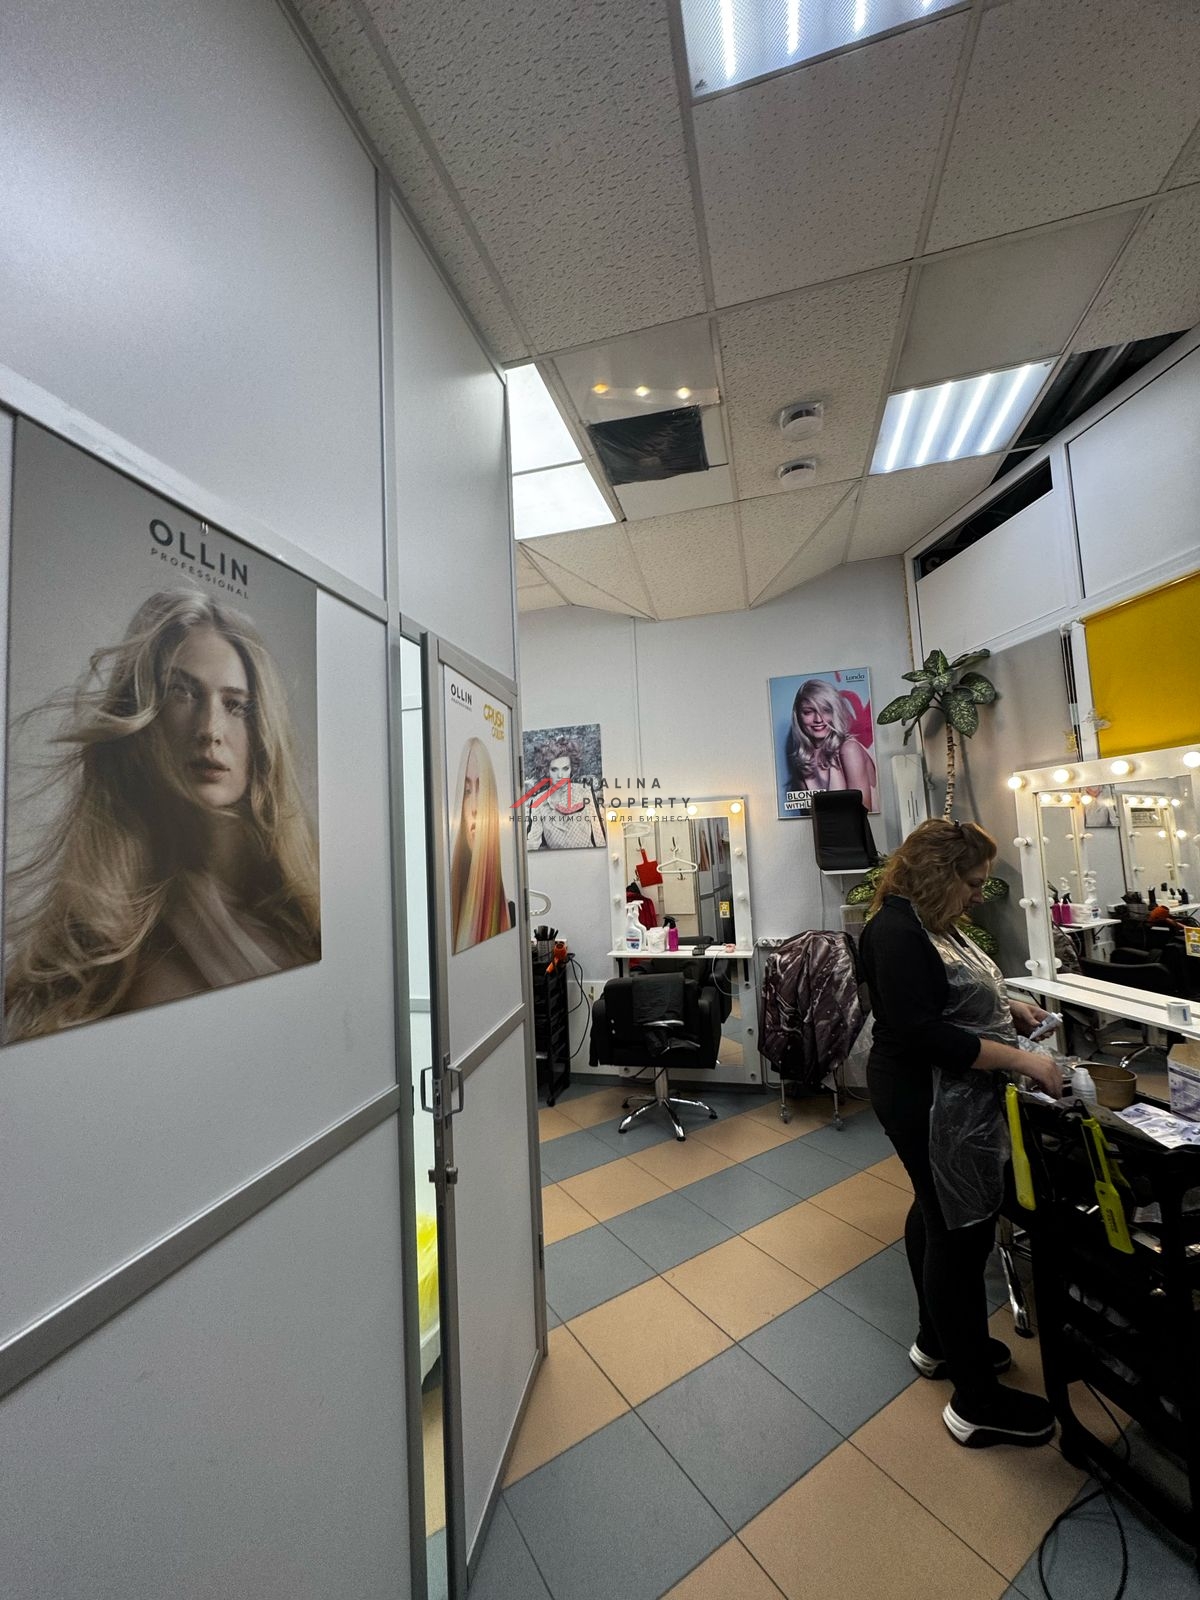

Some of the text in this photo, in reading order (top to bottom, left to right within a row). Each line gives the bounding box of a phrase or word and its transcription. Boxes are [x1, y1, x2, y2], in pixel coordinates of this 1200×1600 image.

[149, 519, 248, 587] OLLIN
[150, 547, 249, 600] PROFESSIONAL
[450, 683, 473, 706] OLLIN
[785, 802, 805, 810] WITH
[787, 791, 822, 800] BLON
